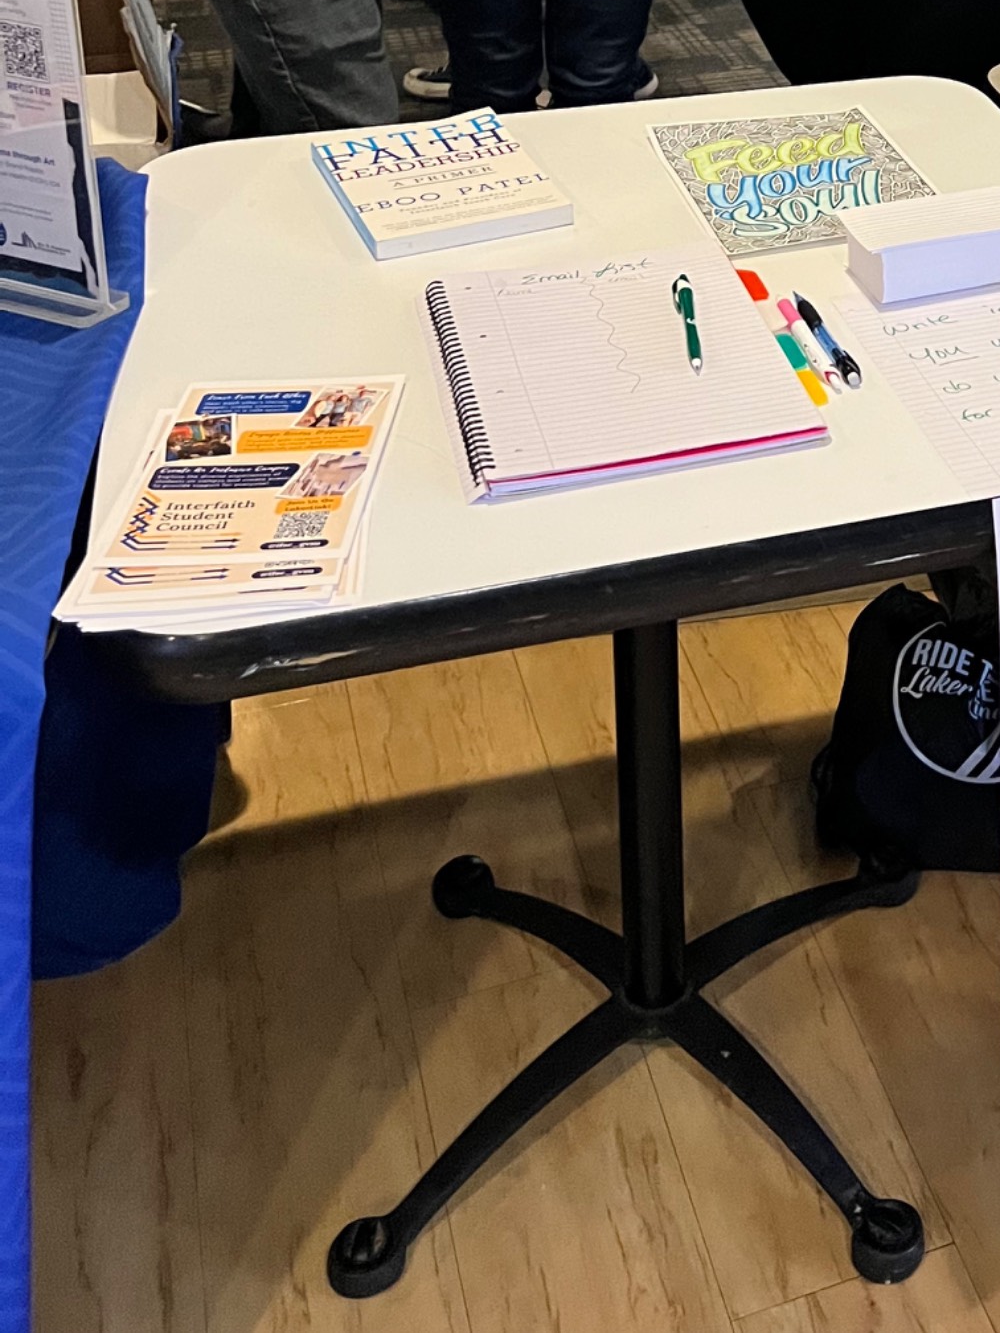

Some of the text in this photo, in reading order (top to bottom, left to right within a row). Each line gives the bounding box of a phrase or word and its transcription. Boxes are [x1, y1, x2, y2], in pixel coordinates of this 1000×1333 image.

[316, 113, 505, 159] INTER
[323, 127, 509, 173] FAITH
[684, 123, 866, 183] Feed
[334, 142, 521, 185] LEADERSHIP
[414, 166, 495, 184] PRIMER
[355, 192, 441, 214] EBOO
[458, 172, 551, 196] PATEL
[706, 157, 872, 220] your
[732, 170, 882, 237] soul
[521, 270, 580, 285] Email
[942, 380, 972, 395] do
[961, 407, 993, 422] for
[160, 511, 234, 521] Student
[165, 500, 256, 511] Interfaith
[156, 521, 228, 531] Council
[912, 638, 975, 676] RIDE
[900, 667, 973, 699] Laker
